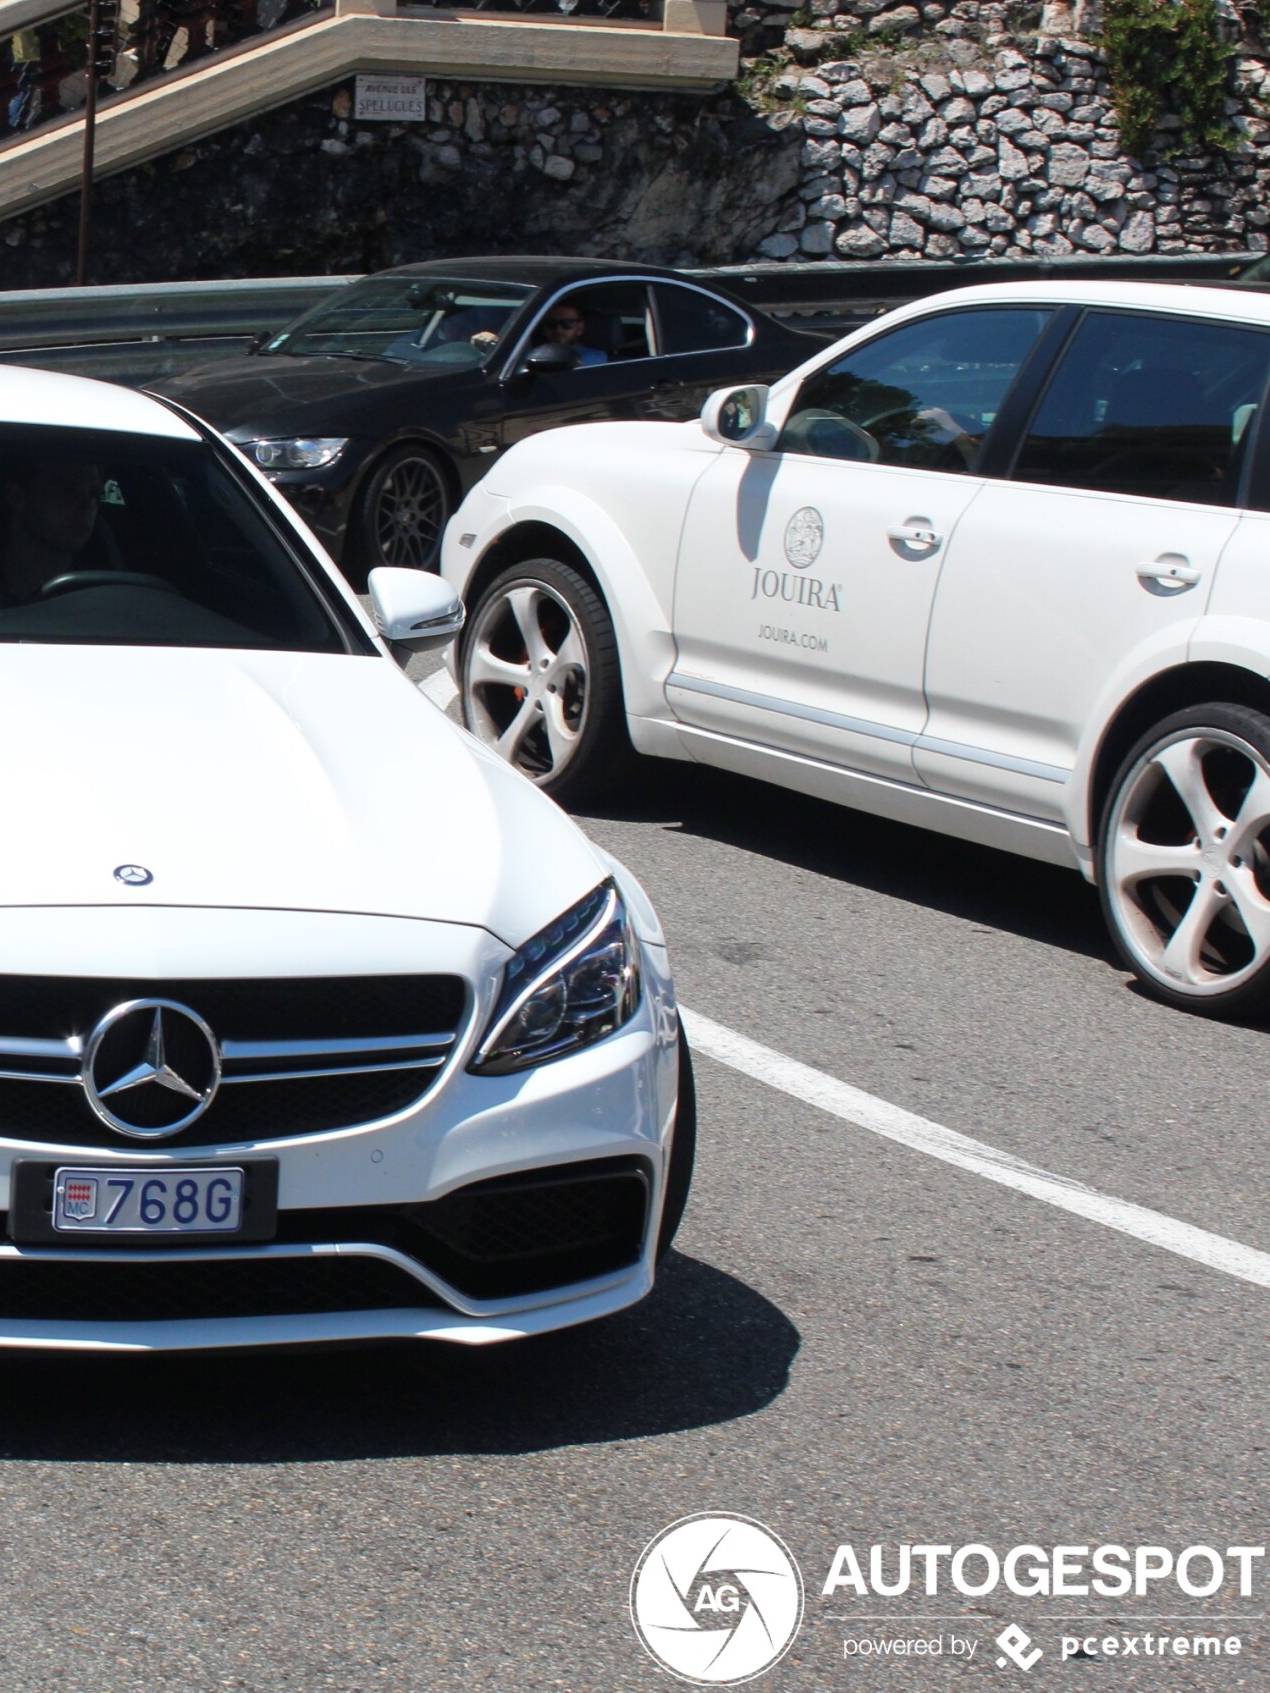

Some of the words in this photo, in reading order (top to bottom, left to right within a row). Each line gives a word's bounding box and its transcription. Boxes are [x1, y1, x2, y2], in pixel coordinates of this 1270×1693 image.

[365, 85, 398, 94] AVENUE
[400, 86, 416, 94] DES
[359, 100, 422, 112] SPELUGUES
[751, 567, 840, 612] JOUIRA
[758, 624, 828, 652] JOUIRA.COM
[67, 1202, 88, 1215] MC
[104, 1178, 232, 1225] 768G
